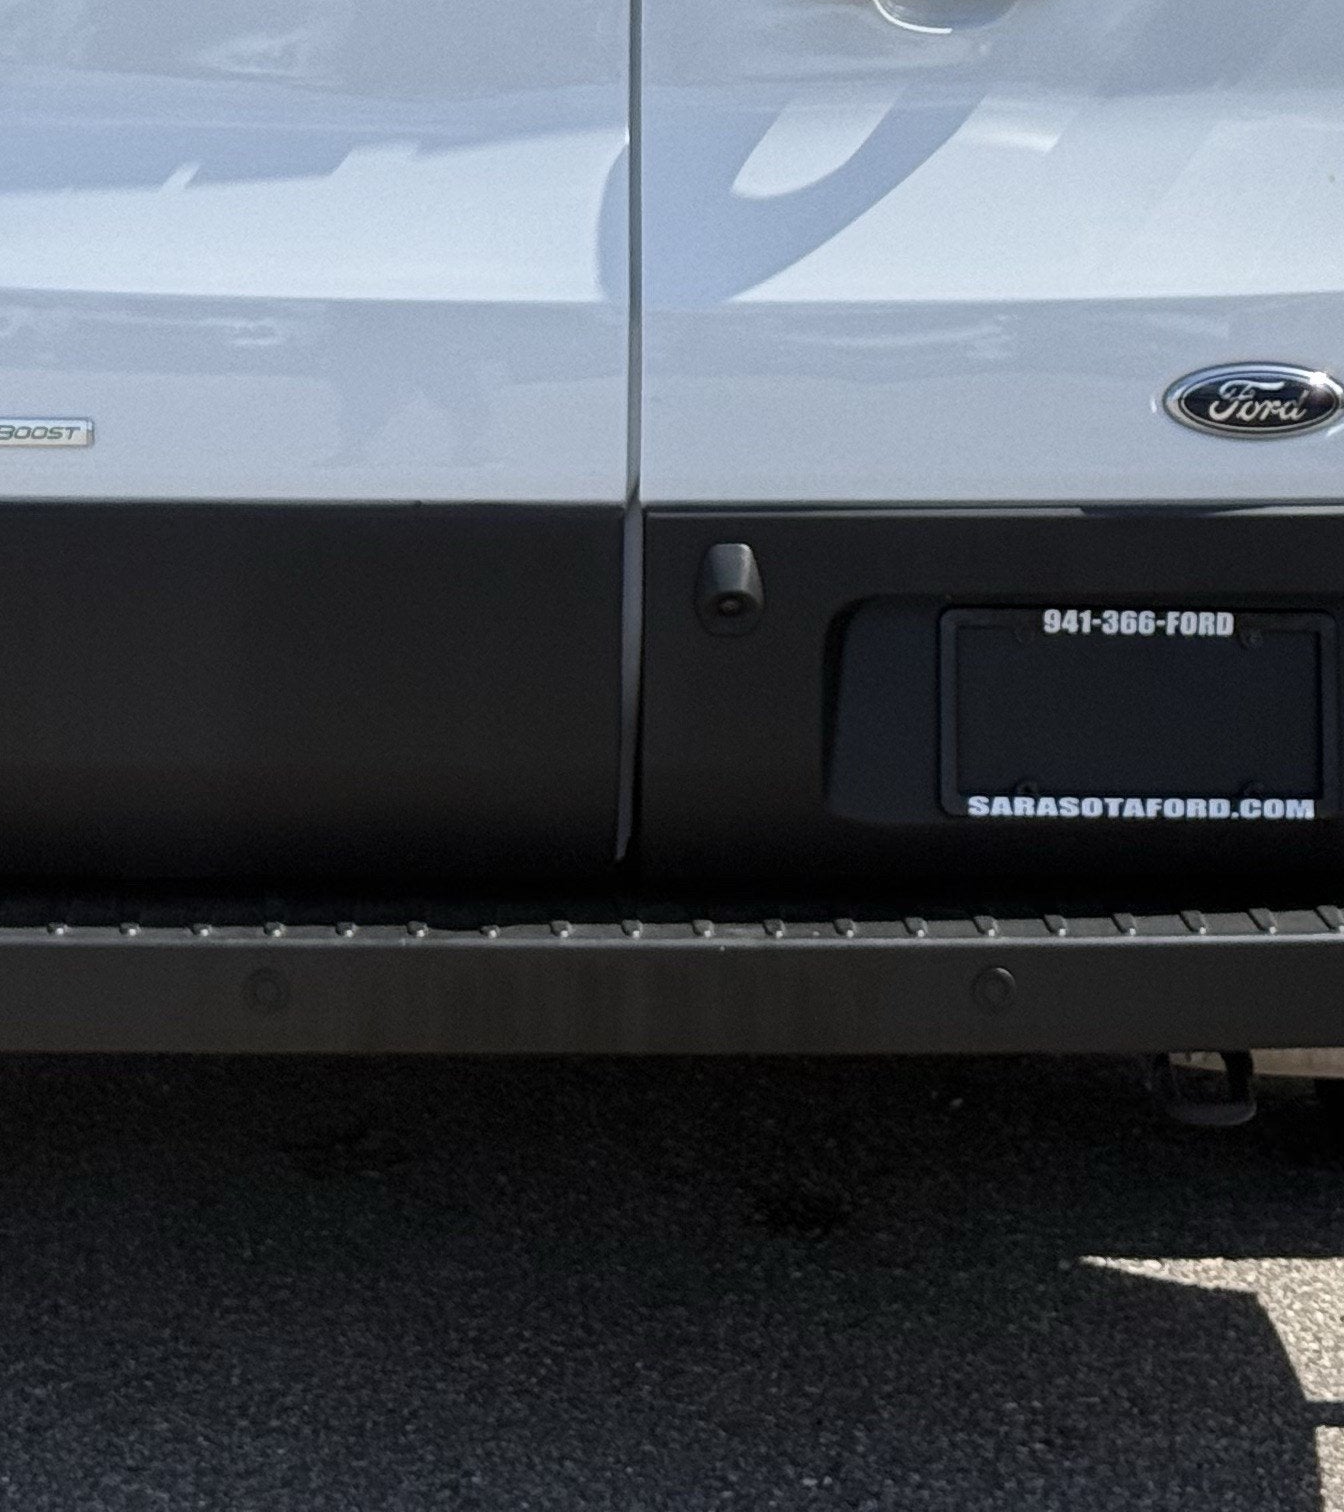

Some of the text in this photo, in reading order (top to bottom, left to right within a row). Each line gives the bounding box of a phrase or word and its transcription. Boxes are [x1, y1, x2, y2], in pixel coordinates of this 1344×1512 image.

[1209, 379, 1309, 421] Ford
[1042, 609, 1235, 637] 941-366-FORD
[967, 795, 1316, 820] SARASOTAFORD.COM
